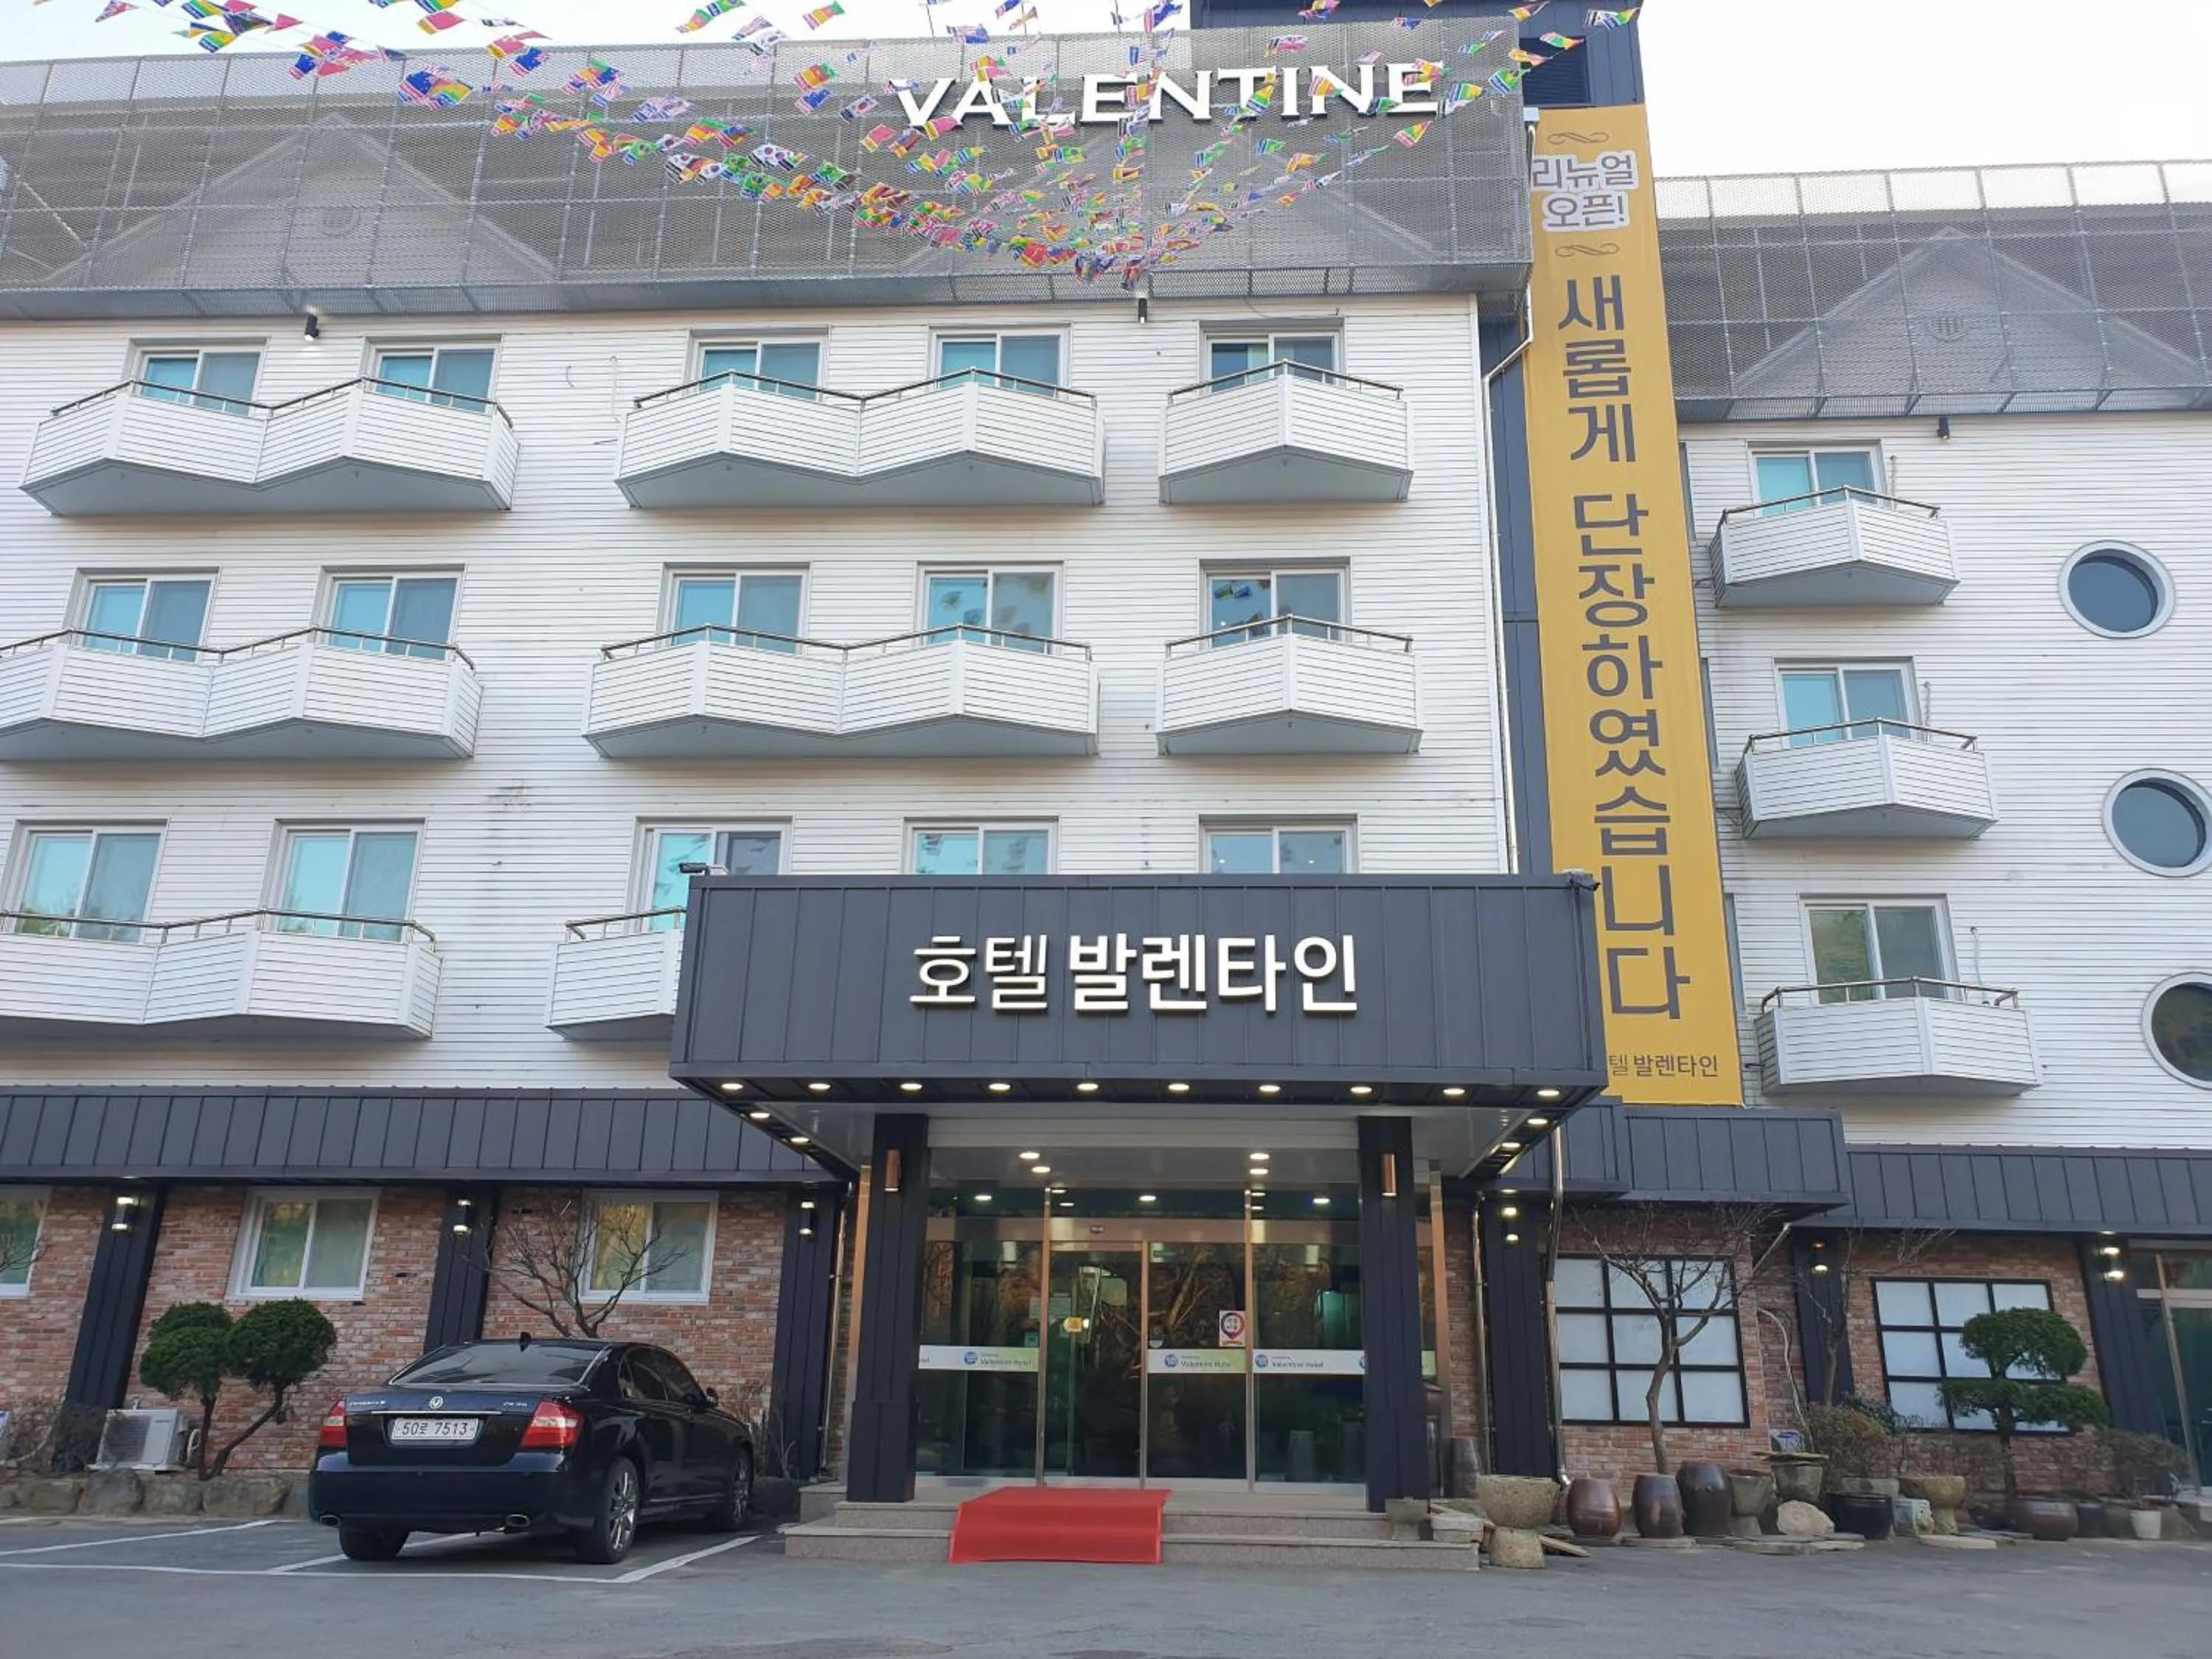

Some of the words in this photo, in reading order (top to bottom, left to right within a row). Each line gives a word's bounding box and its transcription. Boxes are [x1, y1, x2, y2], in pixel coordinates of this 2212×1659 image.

[889, 60, 1443, 128] VALENTINE
[1532, 154, 1634, 189] 리뉴얼
[1547, 194, 1625, 227] 오픈!
[1557, 275, 1636, 462] 새롭게
[1573, 493, 1691, 1019] 단장하였습니다
[908, 933, 1049, 1012] 호텔
[1068, 933, 1358, 1012] 발렌타인
[1609, 1054, 1629, 1076] 텔
[1633, 1054, 1719, 1077] 발렌타인
[434, 1422, 469, 1436] 7513
